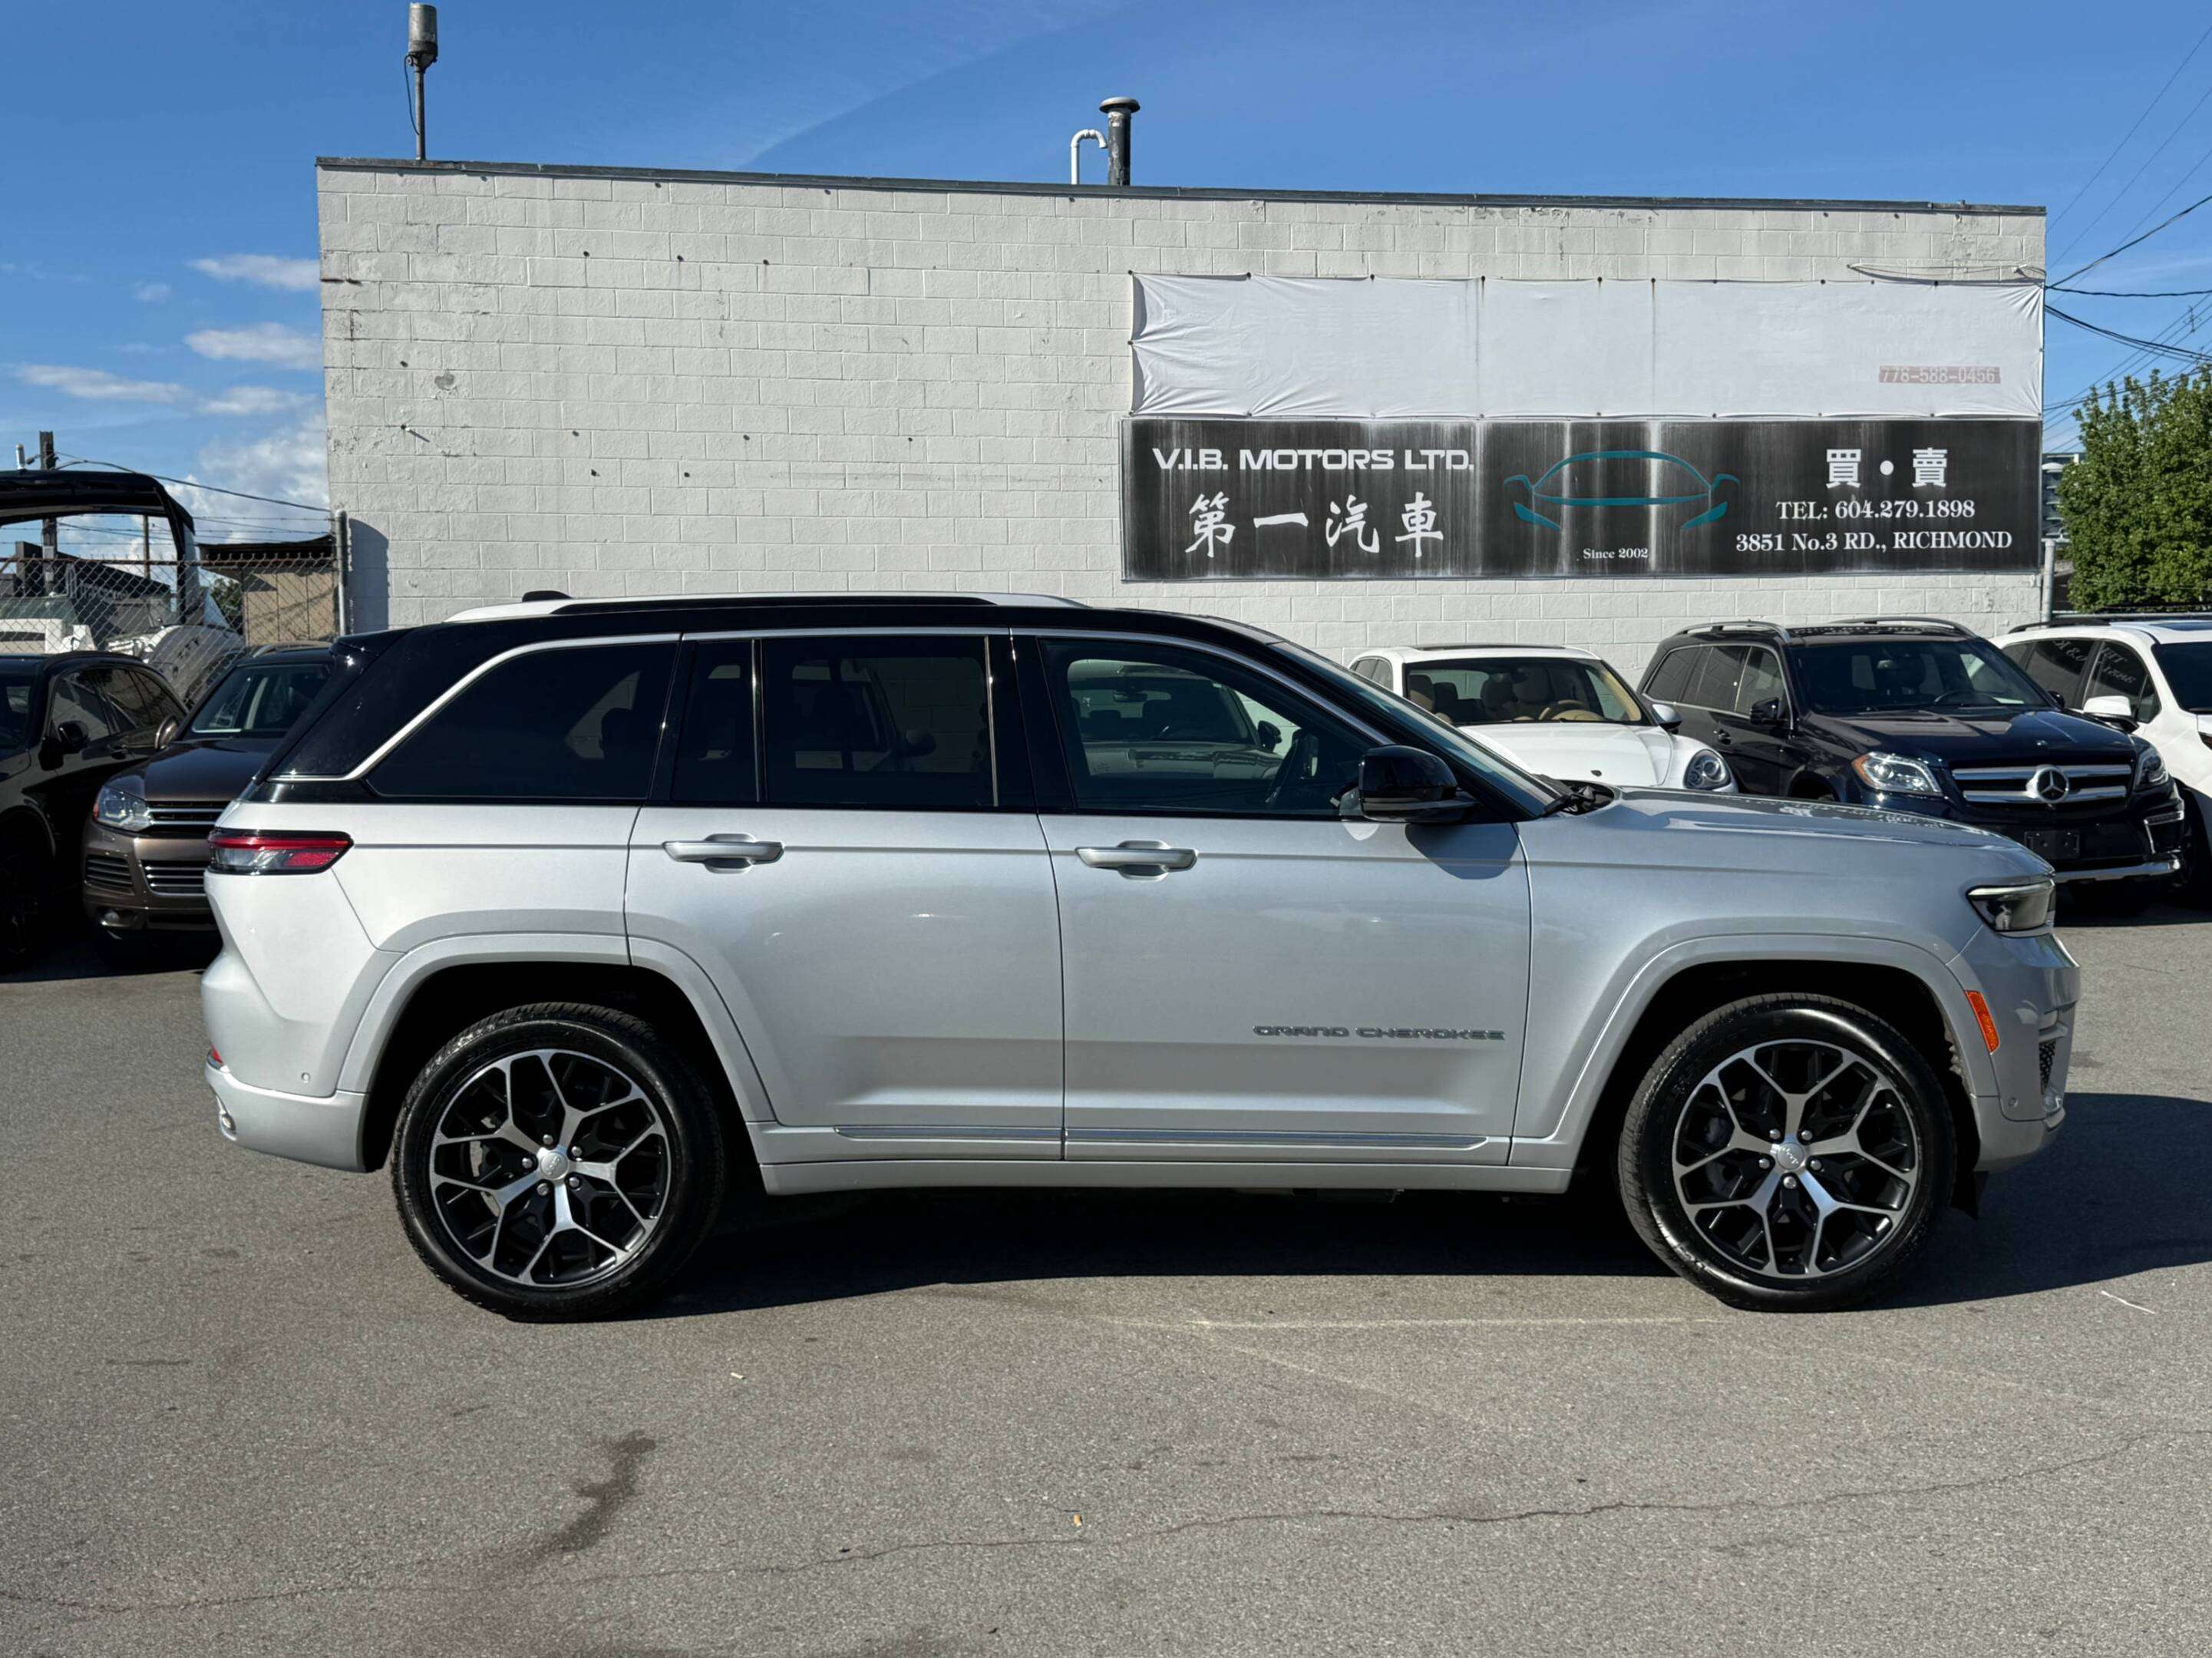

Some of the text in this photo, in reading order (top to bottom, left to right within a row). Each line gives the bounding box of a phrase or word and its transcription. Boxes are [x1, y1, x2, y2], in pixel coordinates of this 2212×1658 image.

[1881, 366, 1997, 383] 778-588-0456
[1152, 448, 1474, 470] V.I.B. MOTORS LTD.
[1775, 500, 1975, 520] TEL: 604.279.1898
[1184, 491, 1444, 558] 第一汽車
[1735, 531, 2012, 552] 3851 No.3 RD., RICHMOND
[1583, 547, 1649, 559] Since 2002
[1253, 1026, 1505, 1041] GRAND CHEROKEE
